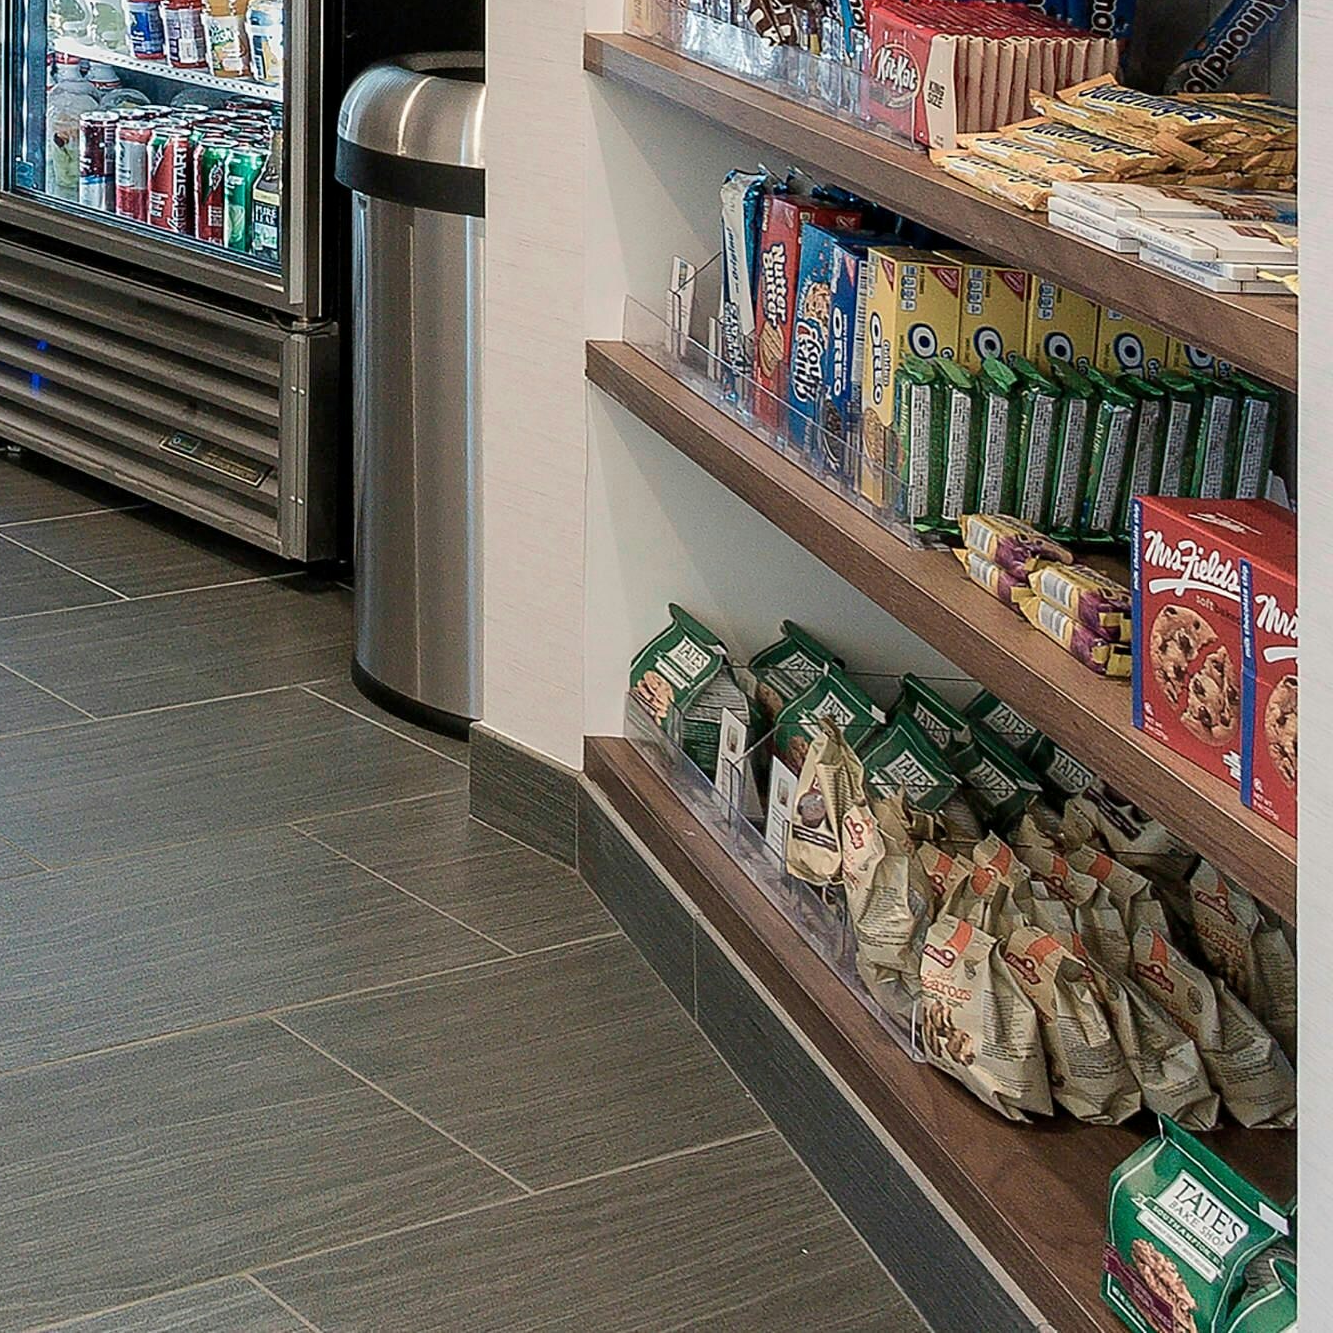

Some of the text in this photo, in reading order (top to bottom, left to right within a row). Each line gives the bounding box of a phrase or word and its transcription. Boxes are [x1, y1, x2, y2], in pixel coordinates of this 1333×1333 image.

[927, 93, 943, 109] SIZE
[255, 205, 278, 216] PURE
[833, 307, 843, 397] OREO
[870, 311, 883, 404] OREO
[1196, 595, 1214, 612] soft
[1242, 587, 1250, 638] chocolate
[1168, 1200, 1201, 1229] BAKE
[1175, 1178, 1243, 1244] TATE'S
